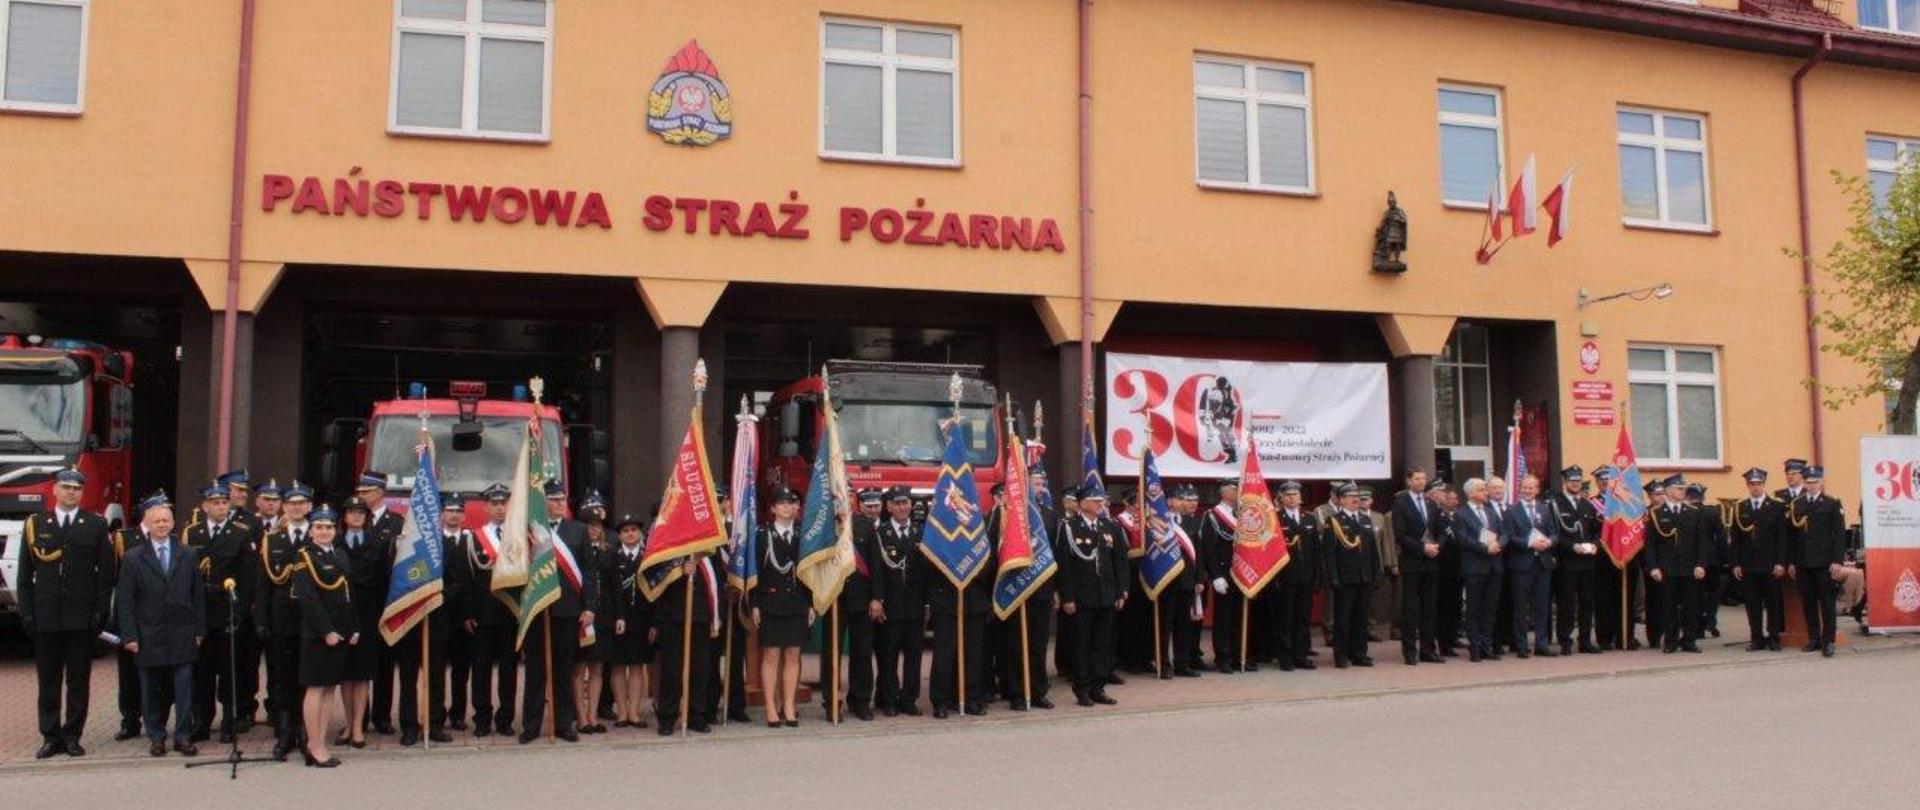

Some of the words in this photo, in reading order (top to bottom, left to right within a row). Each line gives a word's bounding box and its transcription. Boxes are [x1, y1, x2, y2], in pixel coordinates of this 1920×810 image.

[262, 166, 612, 229] PAŃSTWOWA
[643, 190, 810, 239] STRAŻ
[838, 198, 1065, 253] POŻARNA
[1112, 368, 1243, 464] 30
